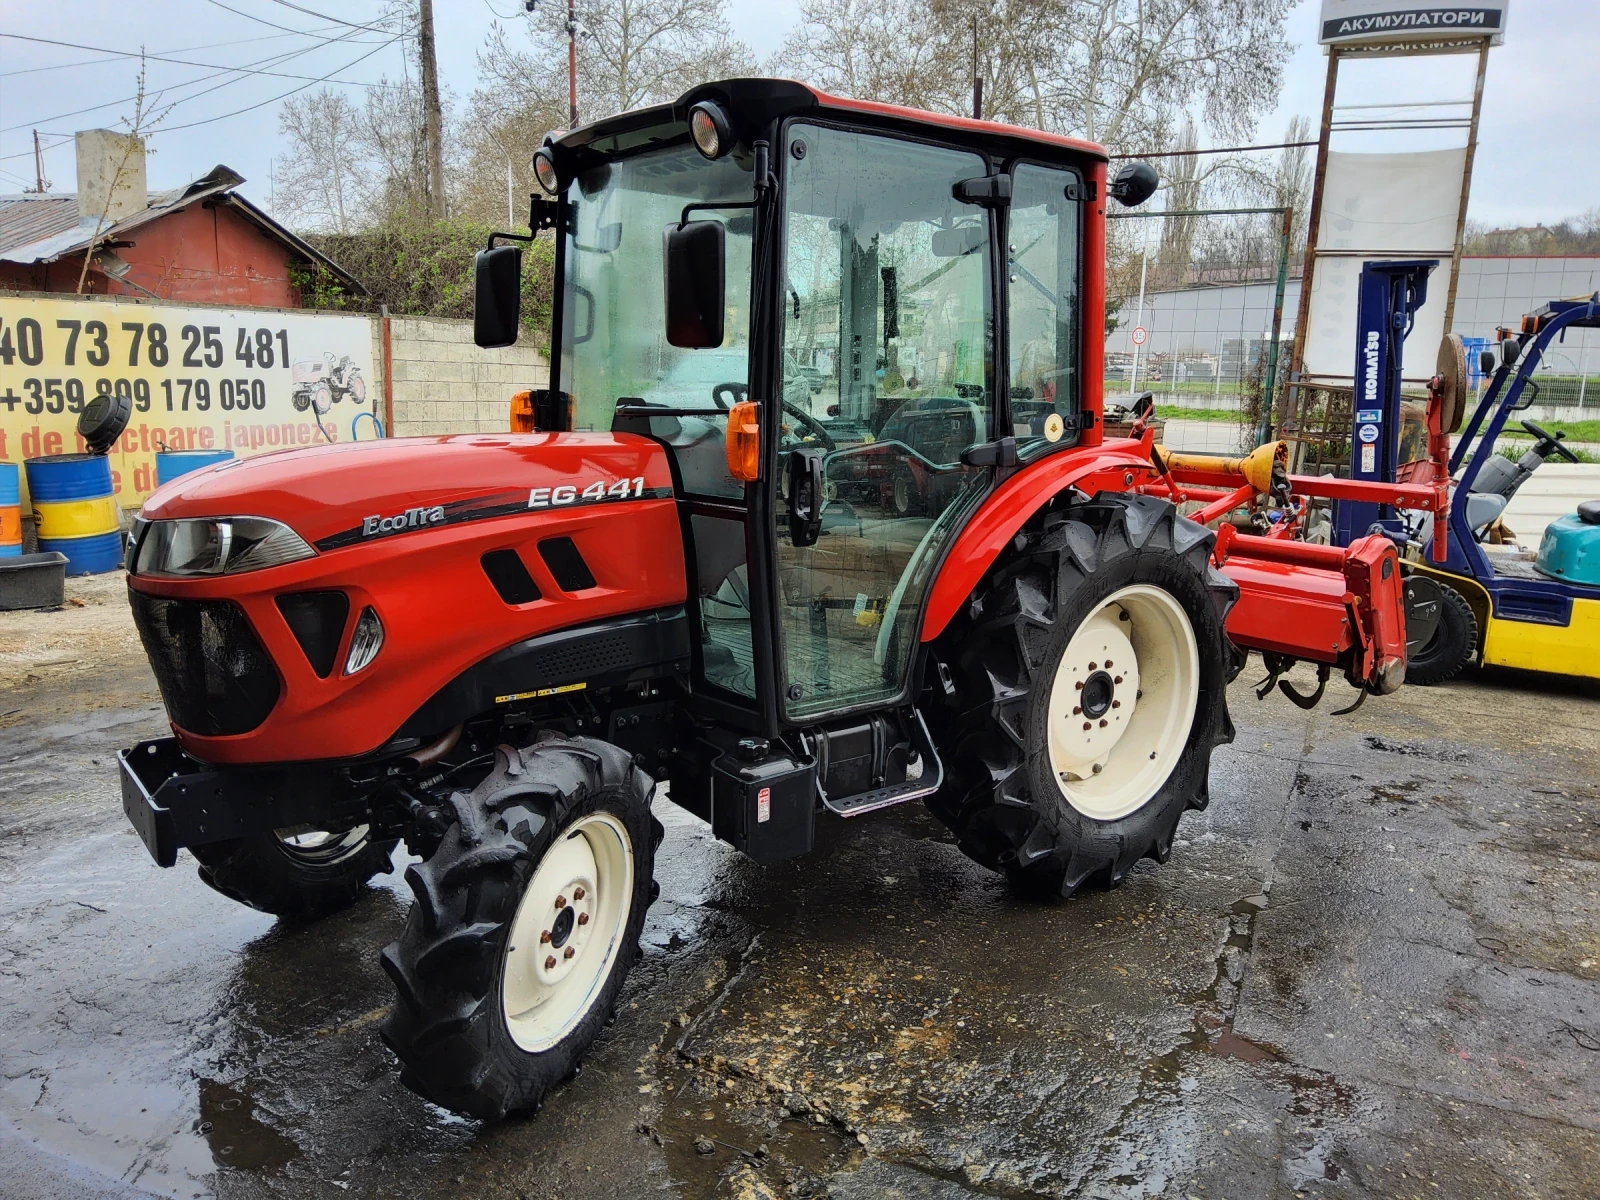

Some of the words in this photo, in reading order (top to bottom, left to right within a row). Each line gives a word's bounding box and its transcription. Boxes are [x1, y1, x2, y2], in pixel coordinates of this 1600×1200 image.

[1338, 11, 1485, 33] АКУМУЛАТОРИ
[0, 316, 43, 366] 40
[56, 319, 110, 367] 73
[121, 321, 169, 368] 78
[180, 324, 224, 369] 25
[235, 326, 290, 370] 481
[1364, 331, 1380, 400] KOMATSU
[0, 377, 86, 415] +359
[160, 378, 211, 412] 179
[219, 378, 266, 411] 050
[21, 425, 64, 459] de
[74, 423, 215, 454] tctoare
[224, 420, 338, 450] japoneze
[527, 485, 577, 508] EG
[582, 476, 645, 501] 441
[362, 505, 445, 537] EcoTra
